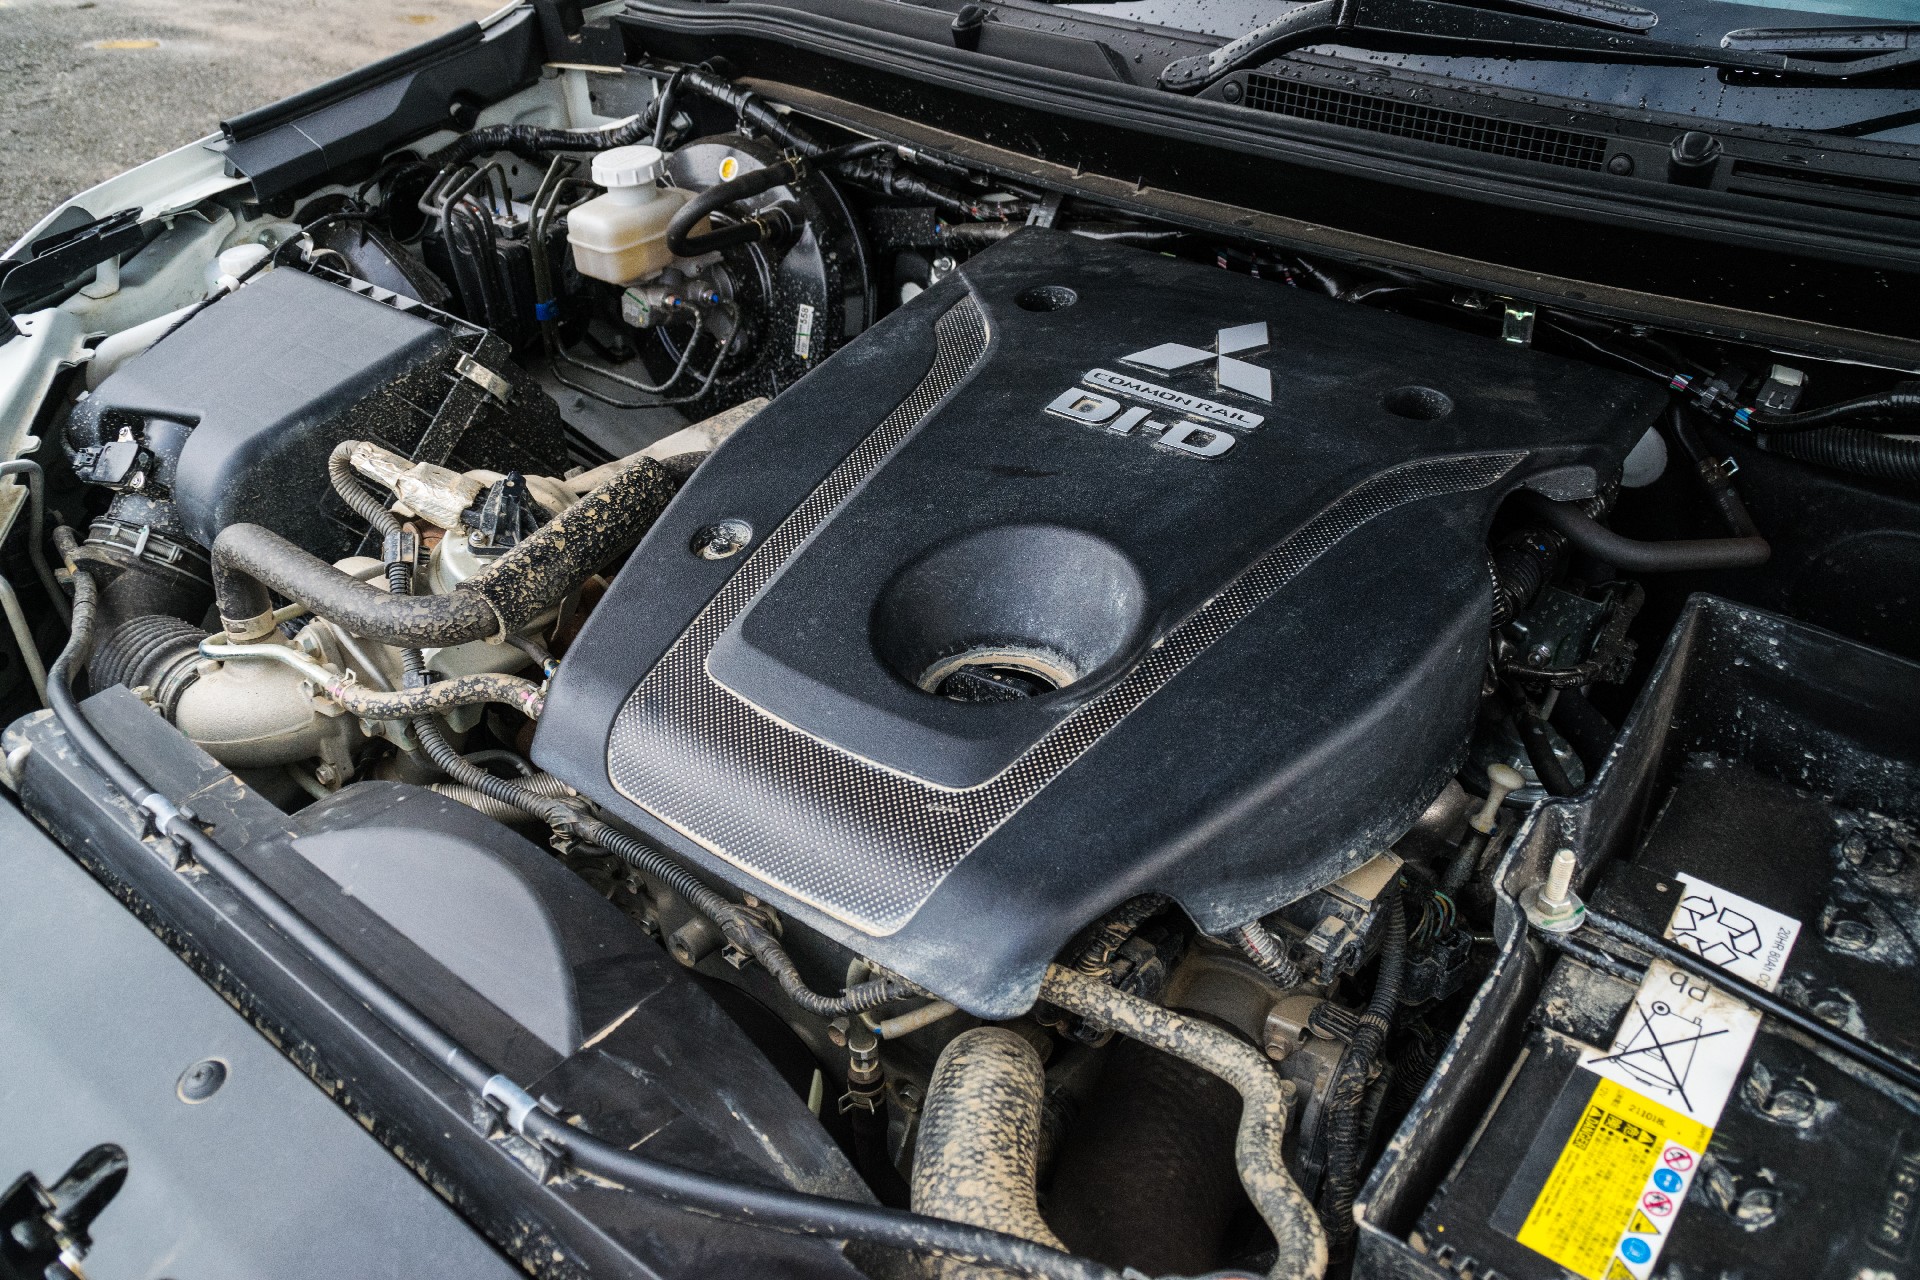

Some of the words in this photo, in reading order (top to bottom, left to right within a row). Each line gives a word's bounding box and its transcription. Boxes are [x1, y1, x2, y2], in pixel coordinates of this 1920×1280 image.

[1093, 371, 1191, 407] COMMON
[1195, 402, 1252, 425] RAIL
[1045, 387, 1237, 459] DI-D
[1772, 926, 1791, 951] 20HR
[1762, 950, 1781, 972] 80Ah
[1670, 971, 1711, 1003] Pb
[1573, 1116, 1602, 1151] DANGER
